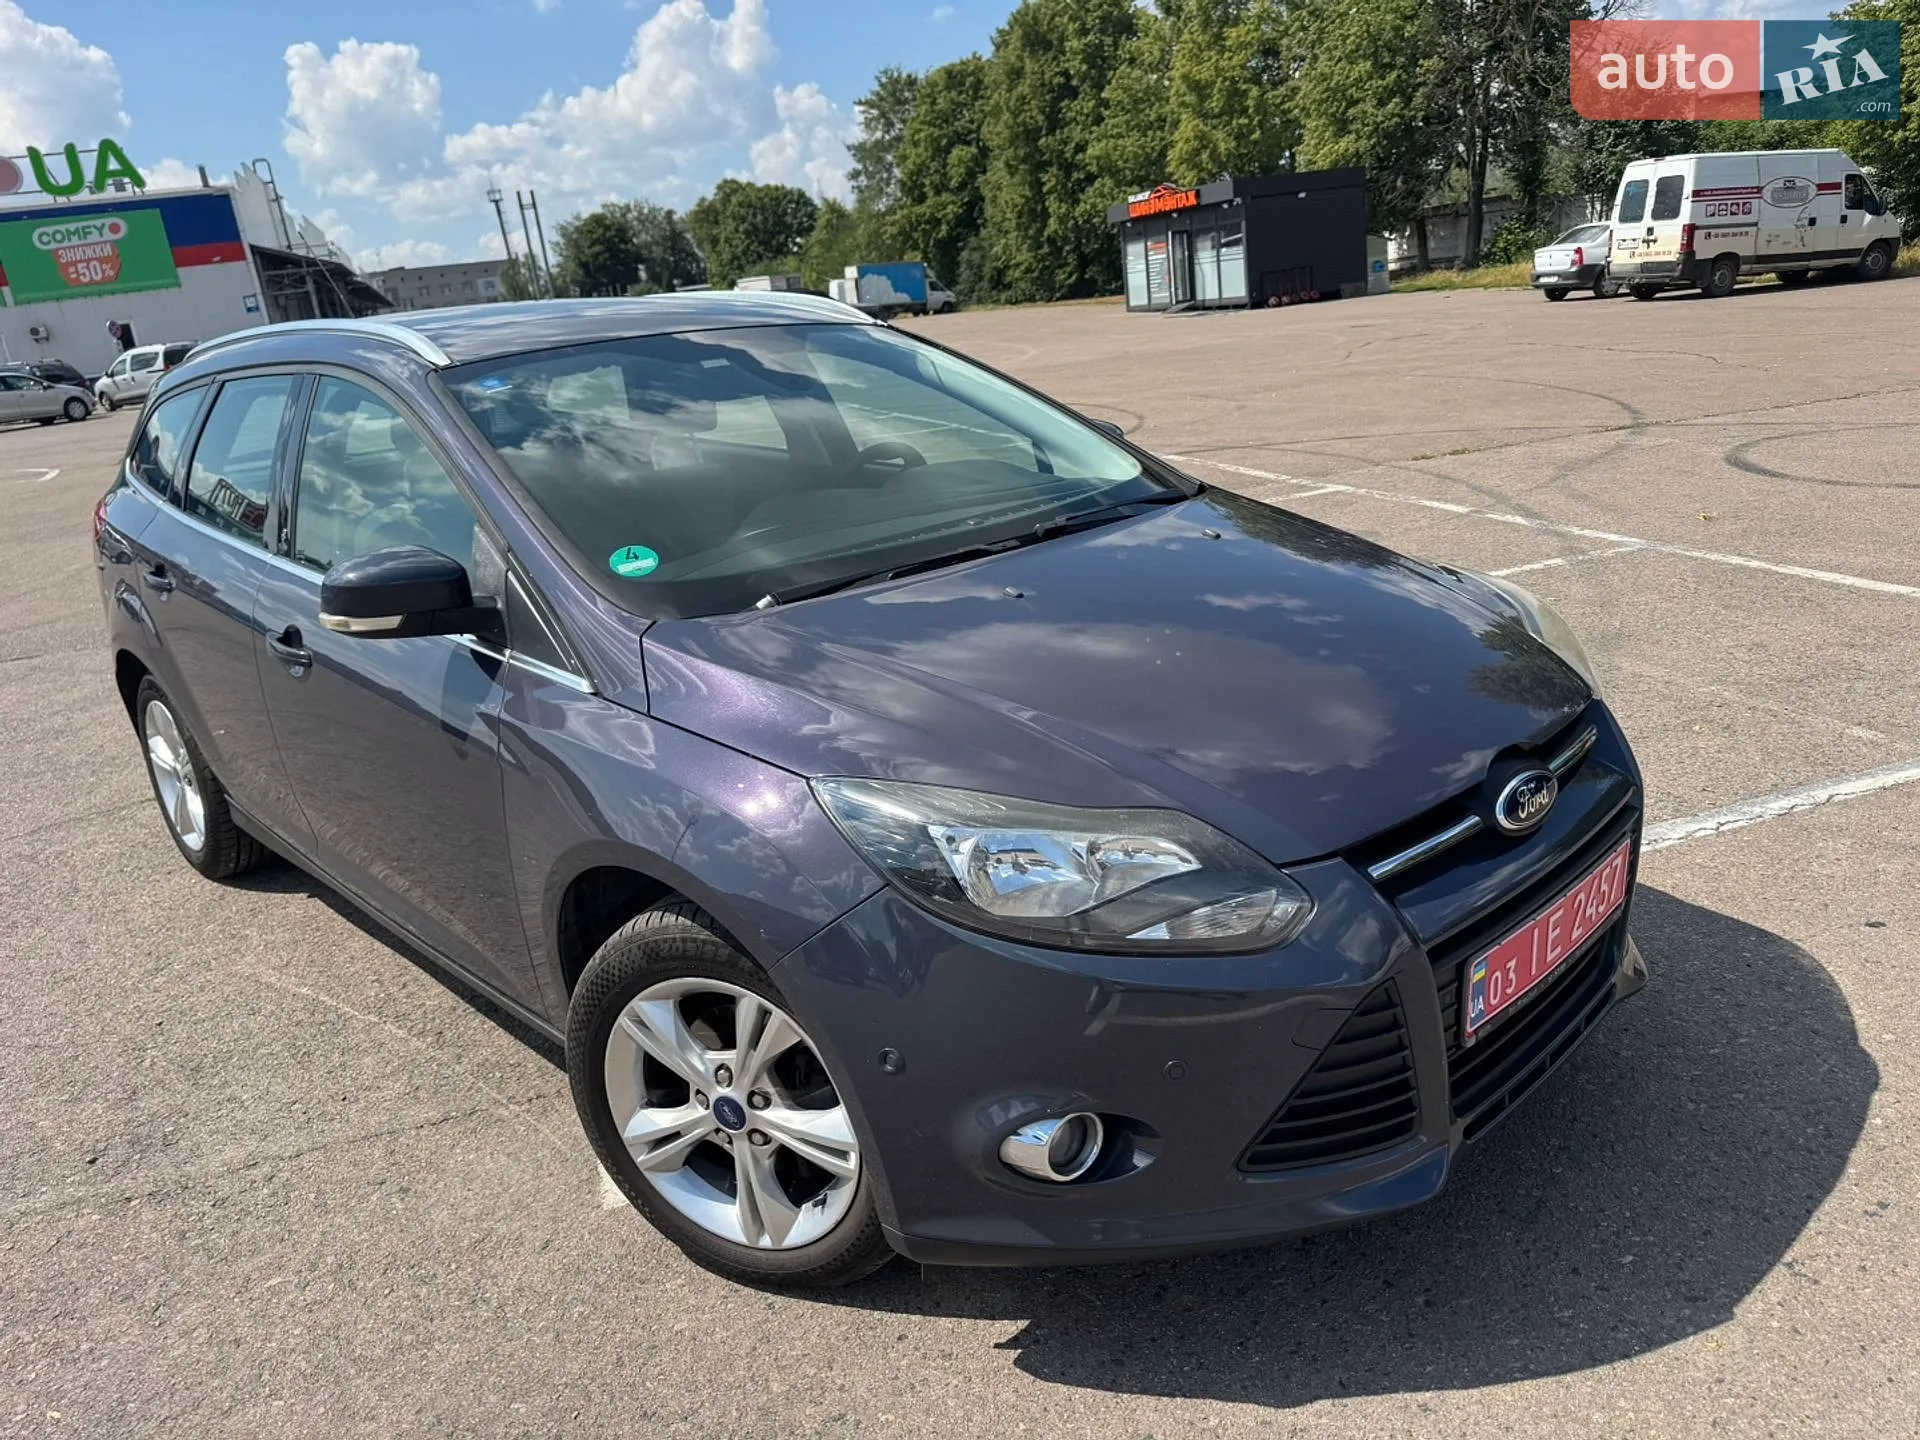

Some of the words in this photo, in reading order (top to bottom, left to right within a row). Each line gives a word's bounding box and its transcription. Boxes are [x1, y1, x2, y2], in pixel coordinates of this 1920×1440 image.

[26, 138, 146, 197] UA
[38, 222, 106, 246] COMFY
[58, 242, 112, 264] ЗНИЖКИ
[626, 547, 639, 560] 4
[1517, 781, 1549, 819] Ford
[1488, 959, 1517, 1006] 03
[1530, 909, 1564, 977] IE
[1571, 853, 1623, 940] 2457
[1470, 996, 1485, 1018] UA
